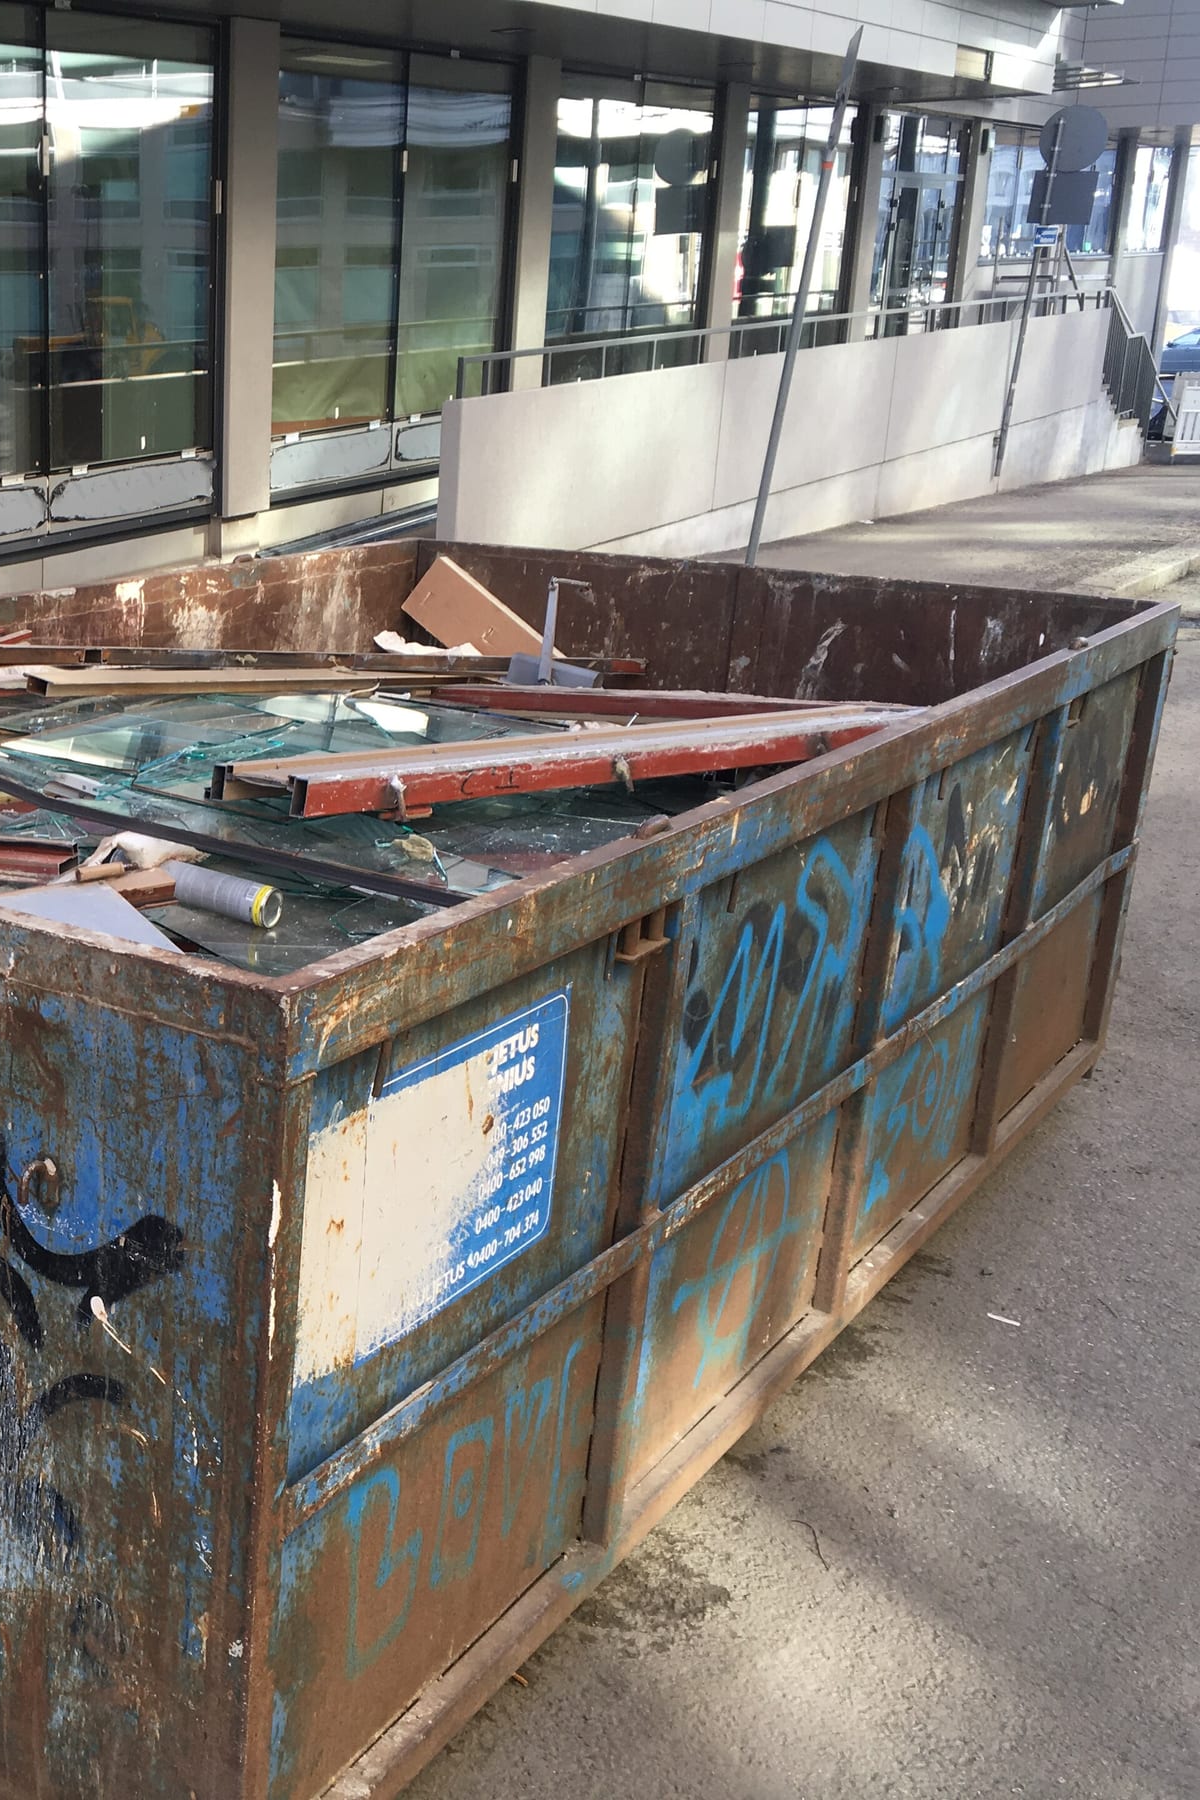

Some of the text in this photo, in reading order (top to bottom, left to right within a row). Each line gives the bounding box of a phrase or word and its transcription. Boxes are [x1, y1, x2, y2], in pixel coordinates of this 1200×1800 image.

[533, 1096, 551, 1119] 050
[530, 1120, 549, 1145] 552
[528, 1144, 547, 1169] 998
[525, 1177, 543, 1201] 040
[523, 1209, 540, 1234] 374
